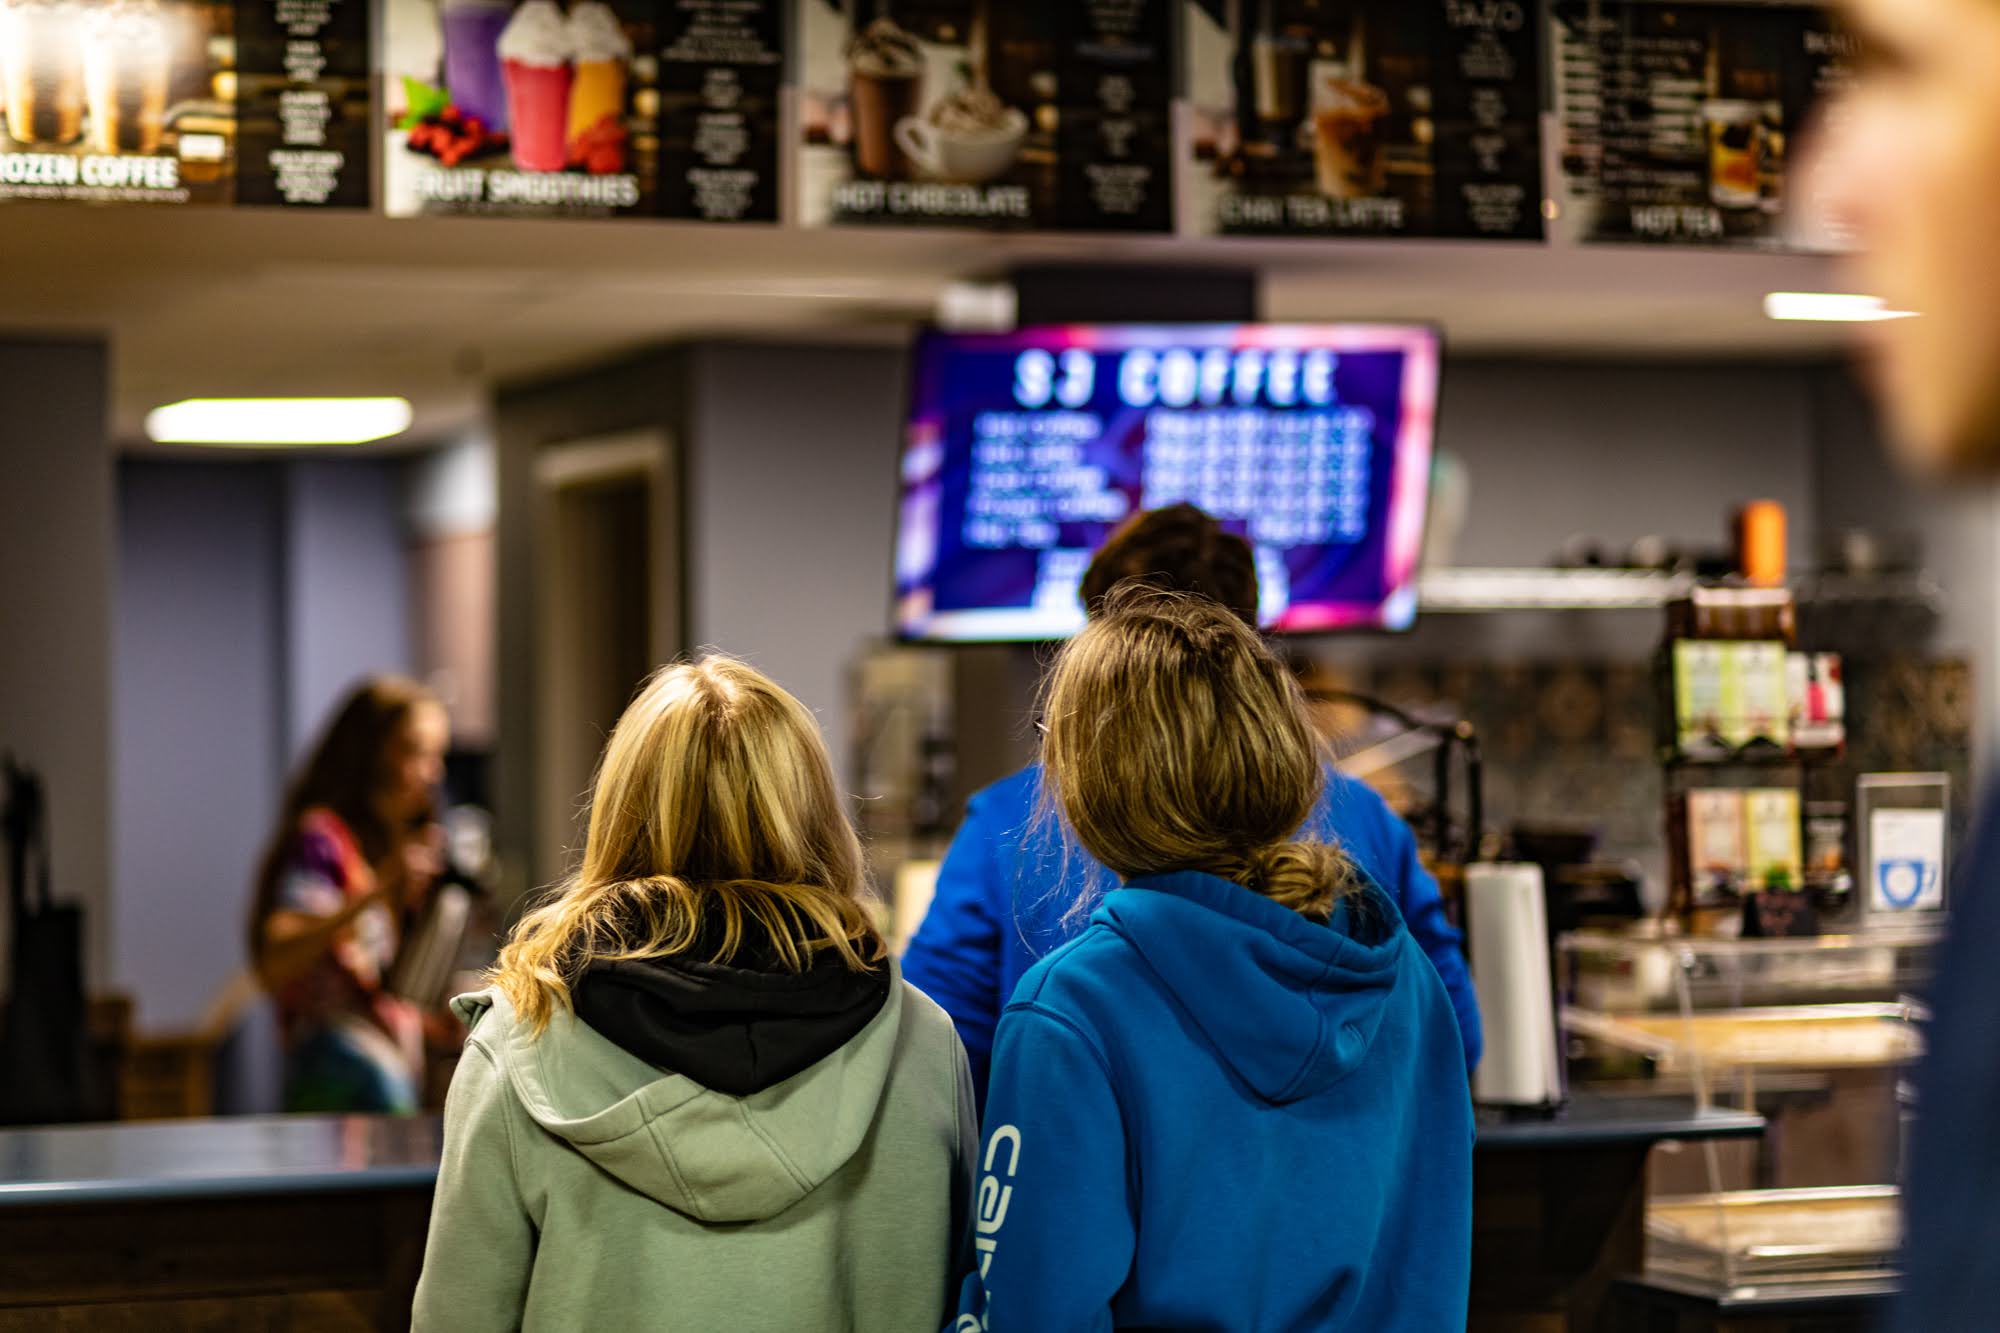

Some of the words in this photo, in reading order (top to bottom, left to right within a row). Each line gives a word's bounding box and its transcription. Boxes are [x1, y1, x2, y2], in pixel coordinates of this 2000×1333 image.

[81, 155, 179, 188] COFFEE
[416, 170, 484, 201] FRUIT
[488, 173, 639, 206] SMOOTHIES
[834, 184, 886, 212] HOT
[889, 186, 1028, 217] CHOCOLATE
[1632, 206, 1675, 234] HOT
[1681, 207, 1722, 237] TEA
[1117, 347, 1337, 408] COFFEE
